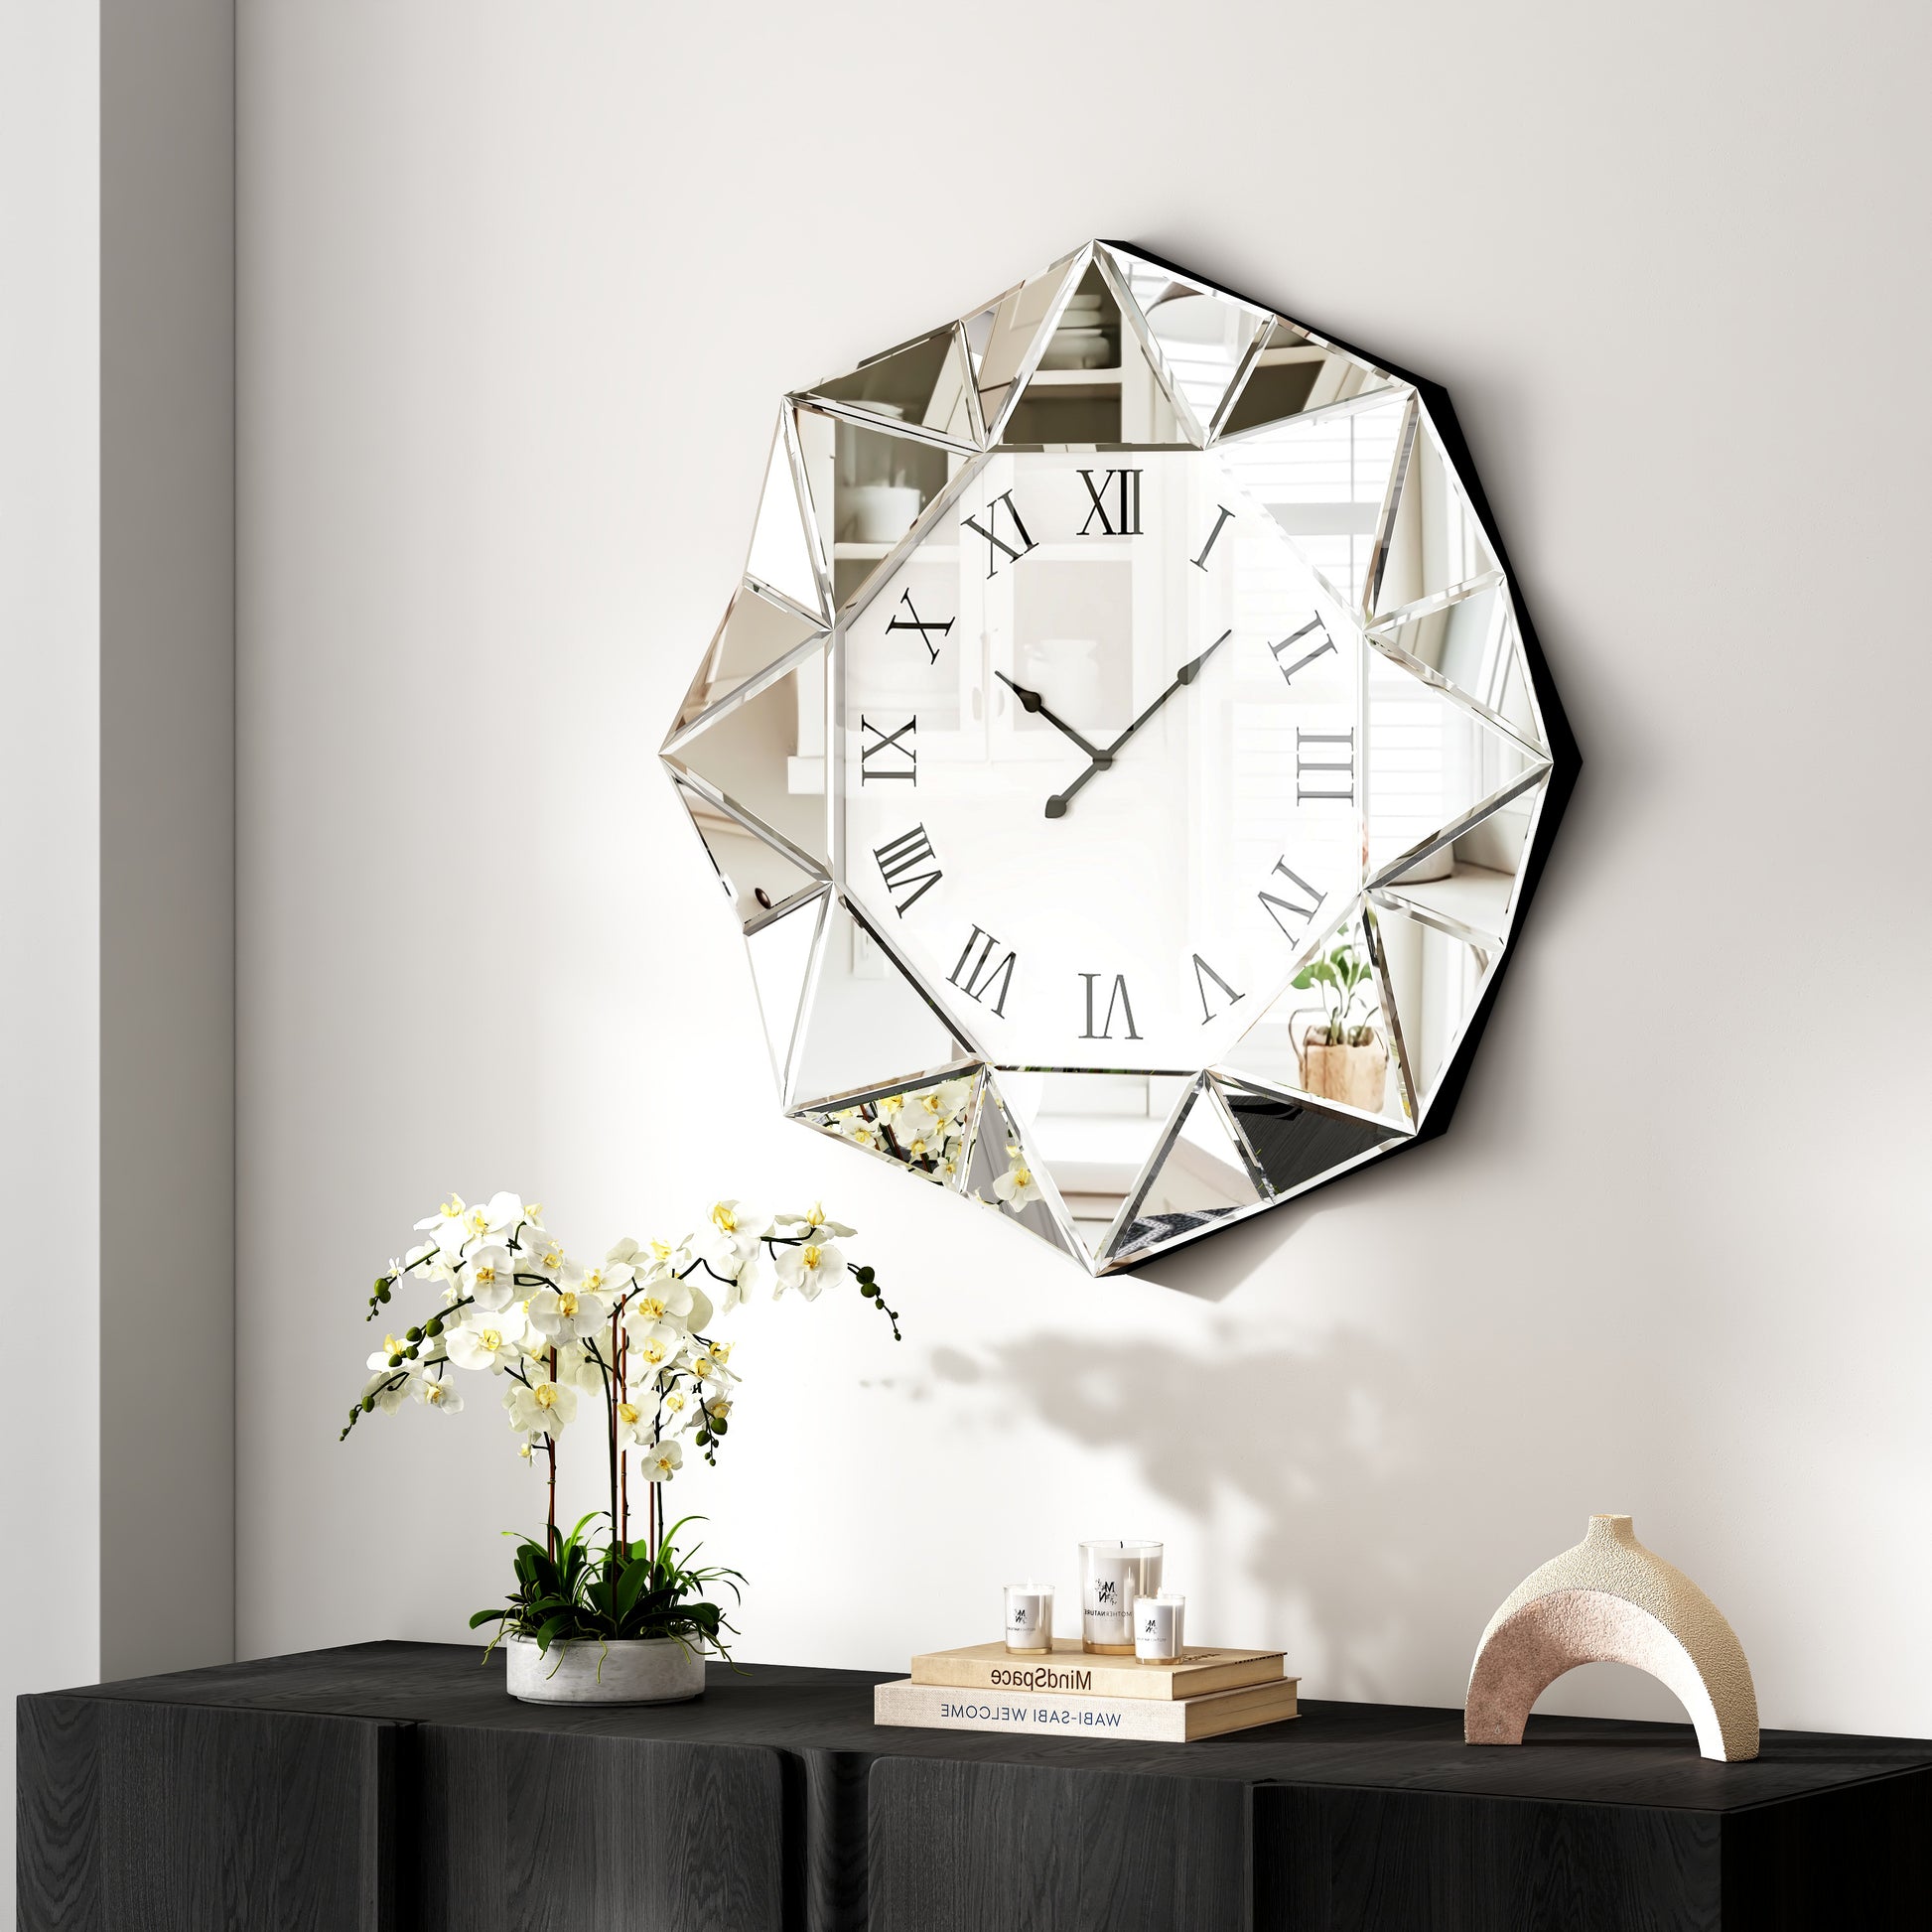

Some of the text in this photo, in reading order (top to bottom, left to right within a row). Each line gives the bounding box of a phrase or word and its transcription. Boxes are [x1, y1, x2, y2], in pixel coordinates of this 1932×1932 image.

[960, 488, 1039, 580] XI
[1076, 469, 1144, 535] XII
[1190, 504, 1236, 572] I
[886, 588, 956, 665] X
[1268, 610, 1338, 685] II
[862, 714, 917, 787] IX
[1297, 726, 1354, 807] III
[873, 822, 943, 919] VIII
[1258, 854, 1328, 951] IV
[945, 923, 1017, 1020] VII
[1077, 973, 1144, 1040] VI
[1192, 953, 1246, 1026] V
